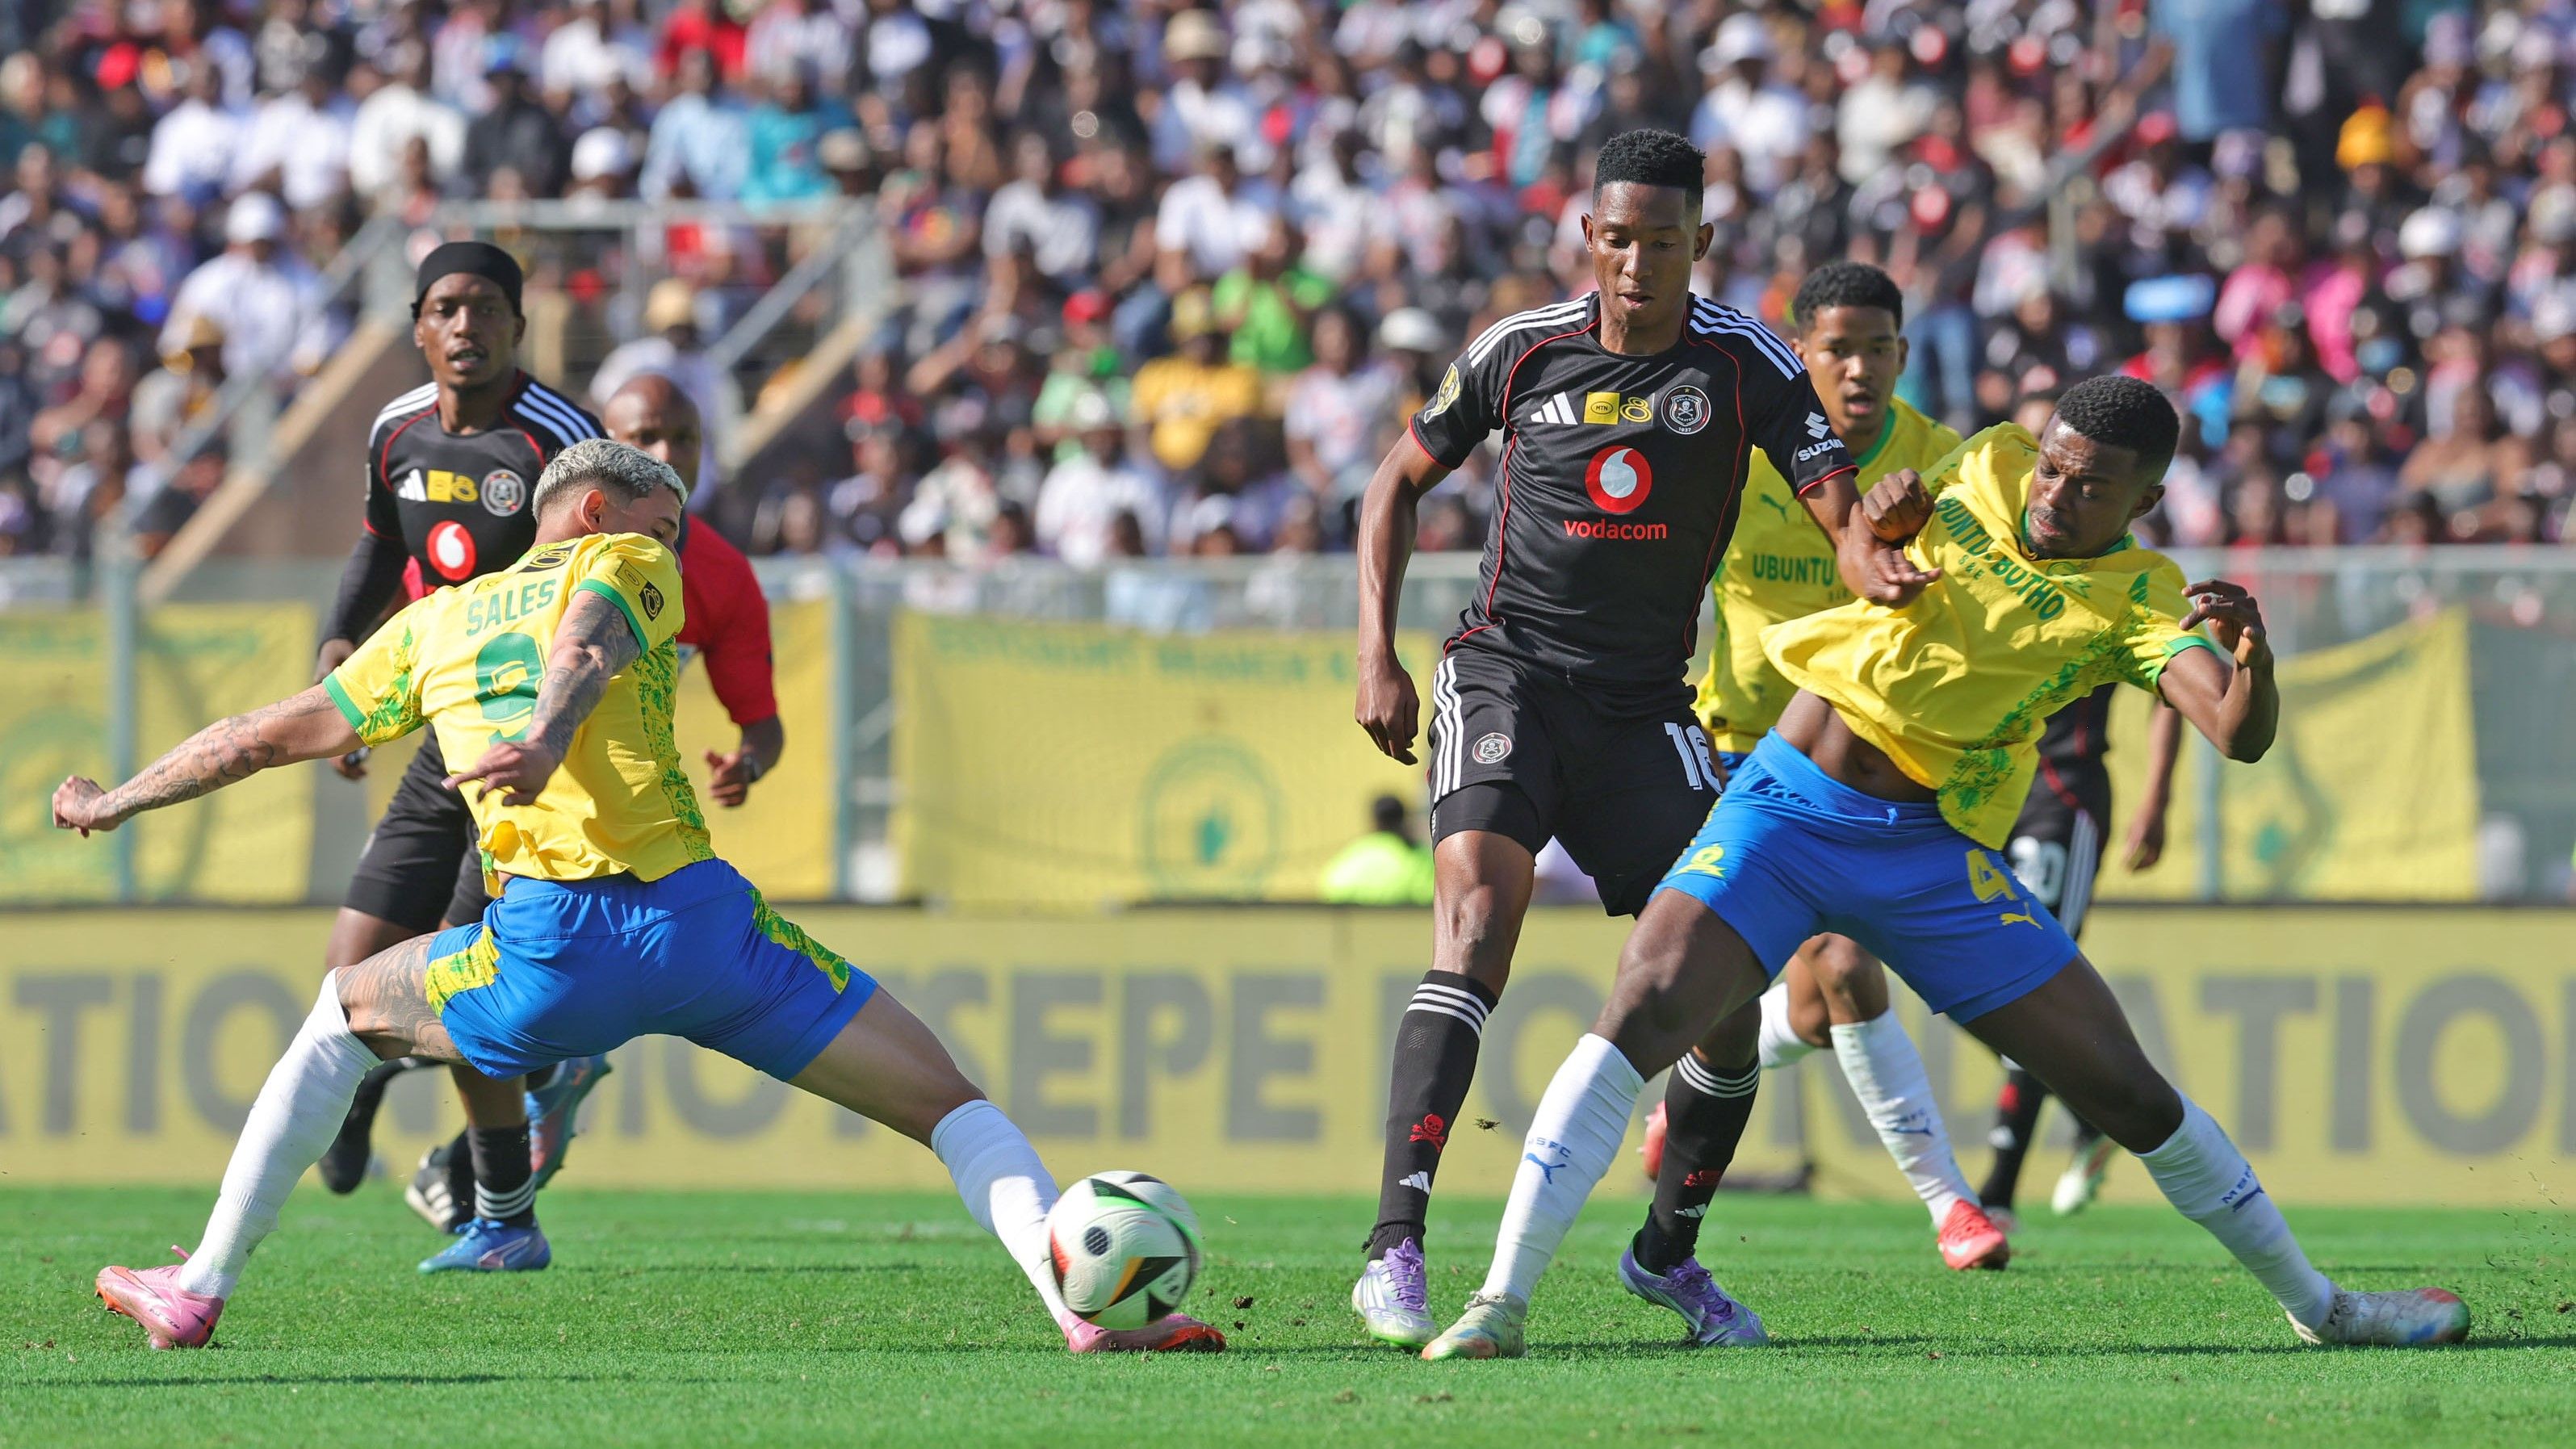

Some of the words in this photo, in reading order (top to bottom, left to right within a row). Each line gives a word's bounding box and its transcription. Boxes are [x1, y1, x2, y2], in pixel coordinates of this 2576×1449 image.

[1564, 518, 1667, 540] vodacom
[1753, 553, 1834, 587] UBUNTU
[467, 579, 556, 636] SALES
[1966, 848, 2017, 903] 4
